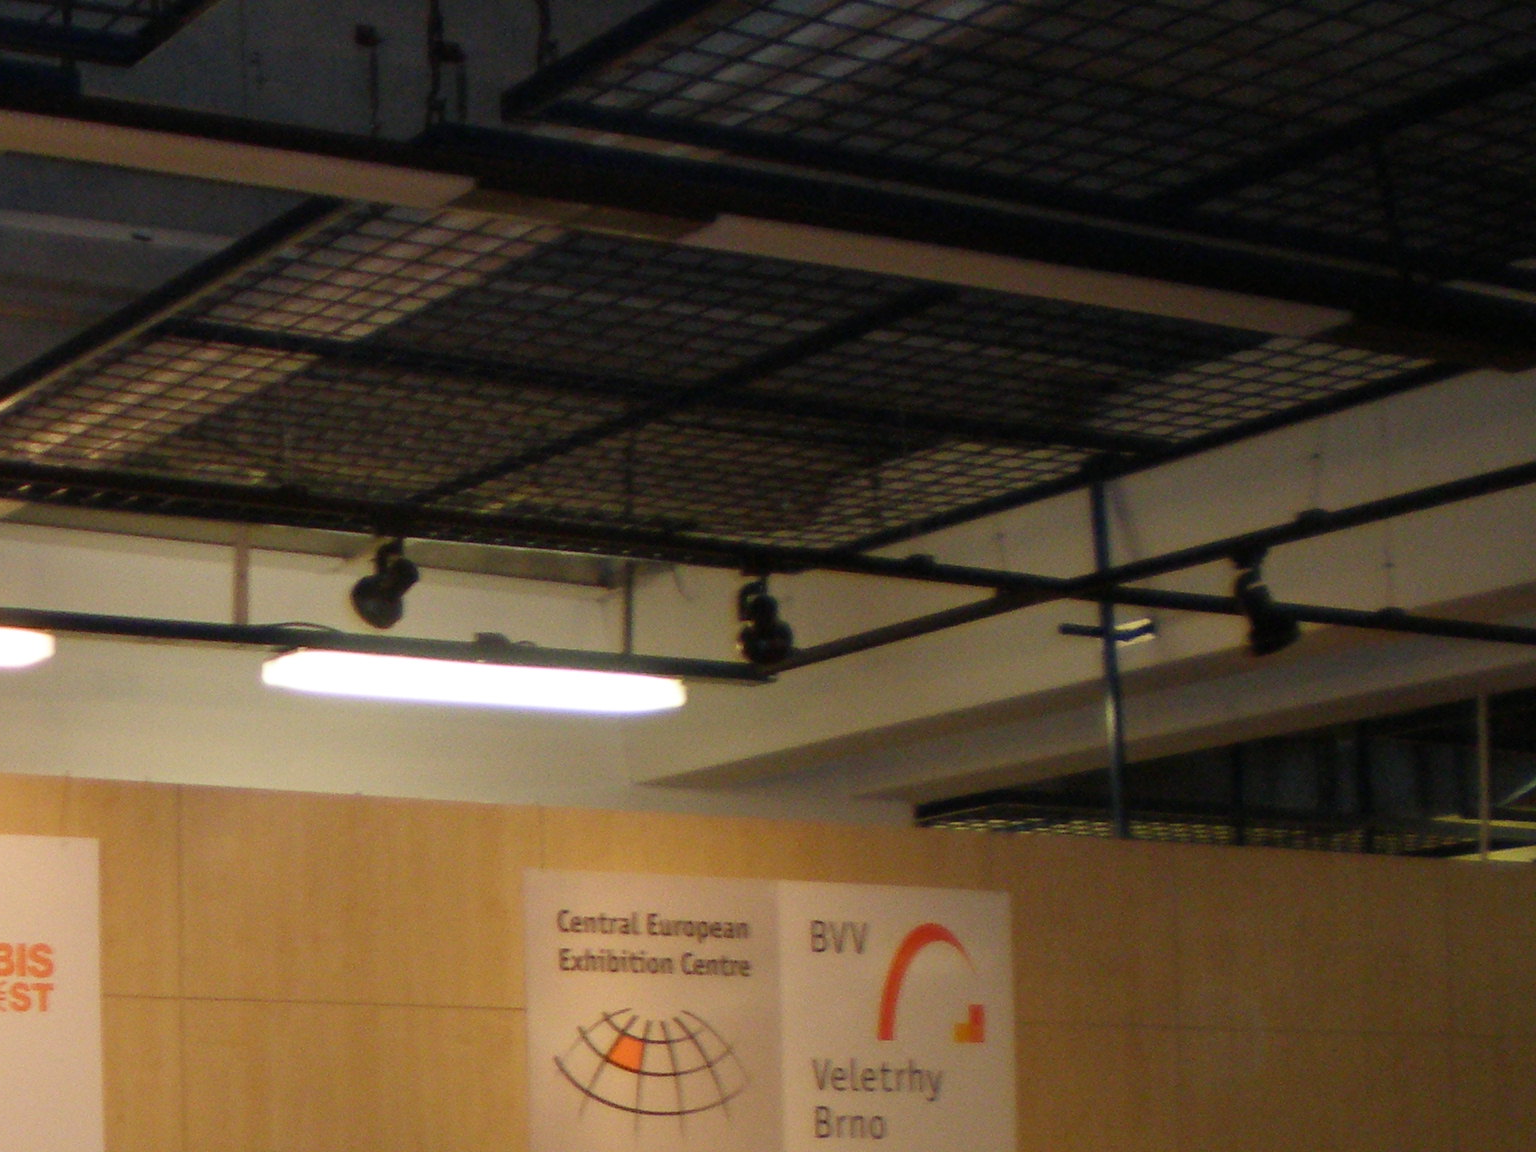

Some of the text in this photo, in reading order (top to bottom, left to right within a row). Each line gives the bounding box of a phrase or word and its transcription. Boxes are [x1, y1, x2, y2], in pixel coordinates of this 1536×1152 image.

[556, 909, 750, 941] Central European
[810, 919, 867, 953] BVV
[559, 948, 752, 977] Exhibition Centre
[813, 1058, 942, 1101] Veletrhy
[814, 1106, 887, 1140] Brno
